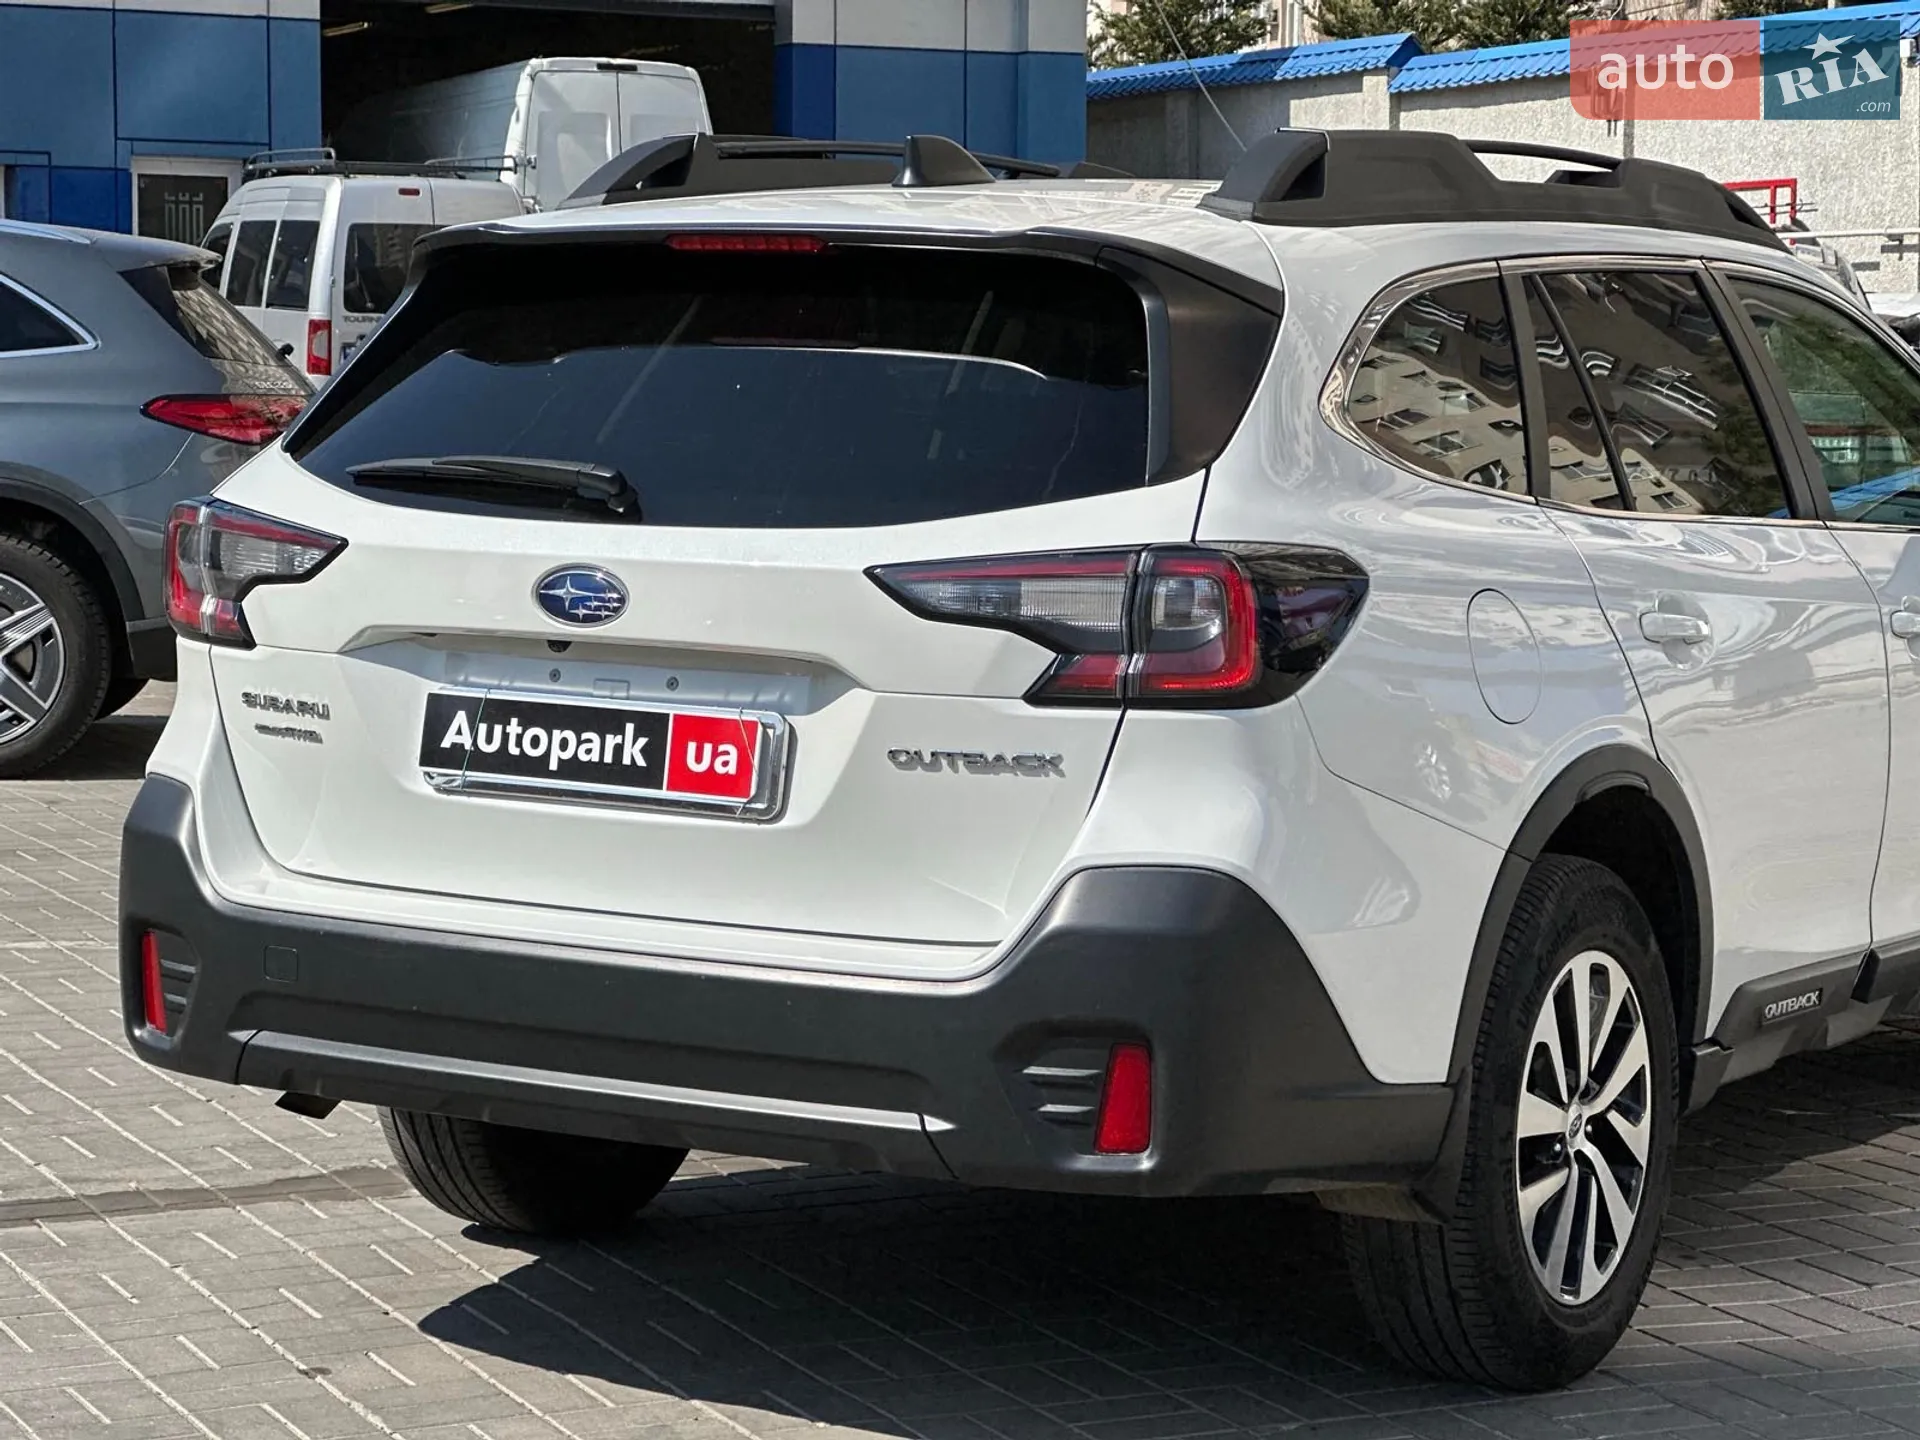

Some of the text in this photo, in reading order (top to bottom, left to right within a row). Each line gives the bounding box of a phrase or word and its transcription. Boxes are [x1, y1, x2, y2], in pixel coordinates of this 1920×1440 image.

[241, 688, 331, 720] SUBARU
[440, 710, 738, 775] Autopark ua
[887, 748, 1067, 778] OUTBACK
[1765, 991, 1819, 1018] OUTBACK
